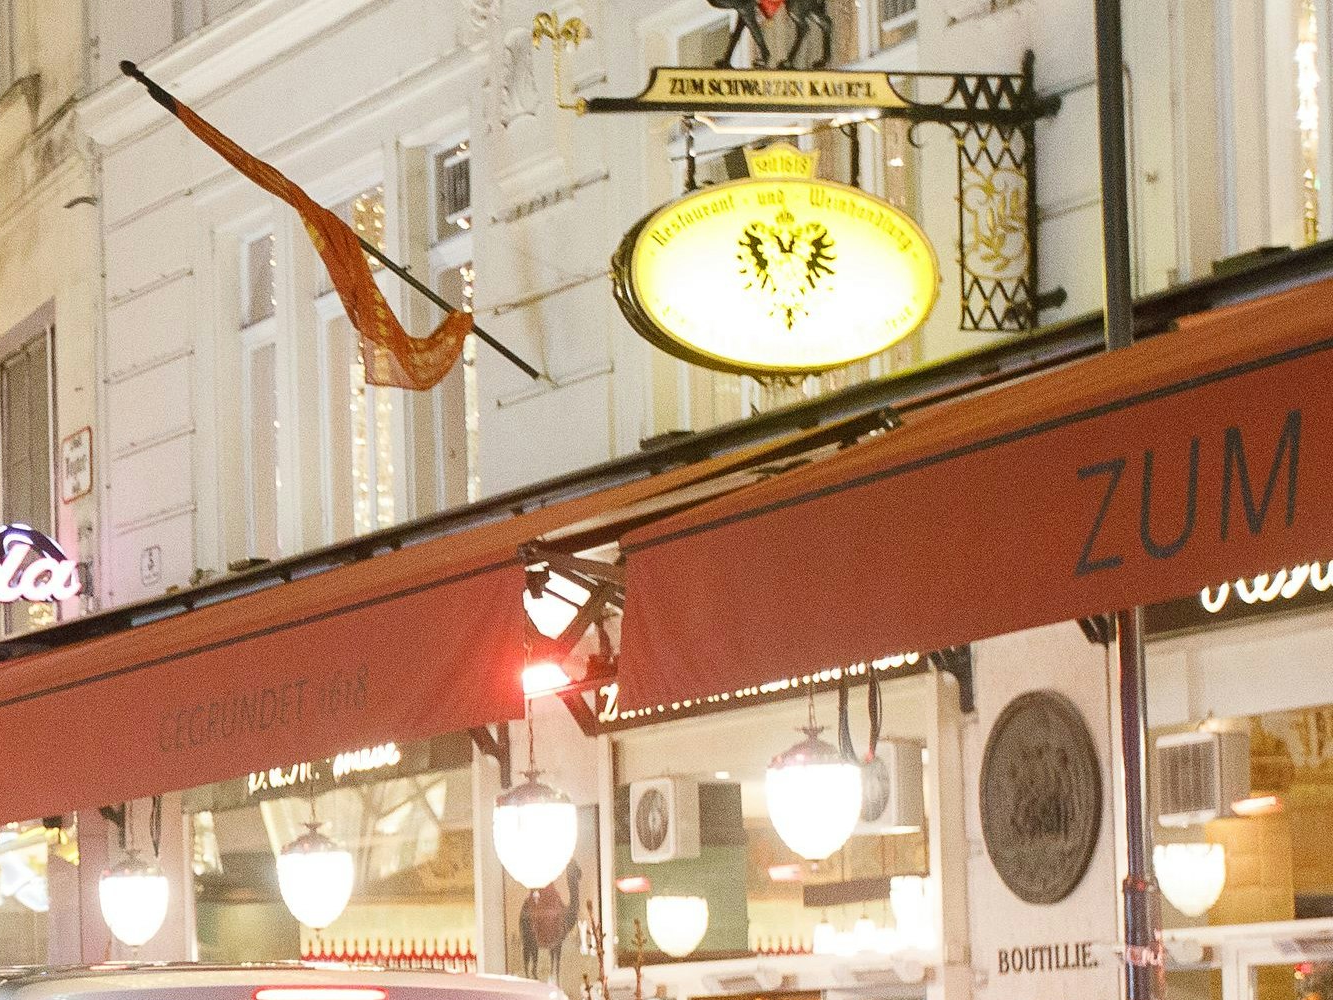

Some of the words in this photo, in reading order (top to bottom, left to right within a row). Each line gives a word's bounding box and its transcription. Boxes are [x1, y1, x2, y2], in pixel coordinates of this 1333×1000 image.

[669, 77, 705, 97] ZUM
[651, 193, 735, 248] Restaurant
[757, 189, 784, 206] und
[1075, 410, 1301, 576] ZUM
